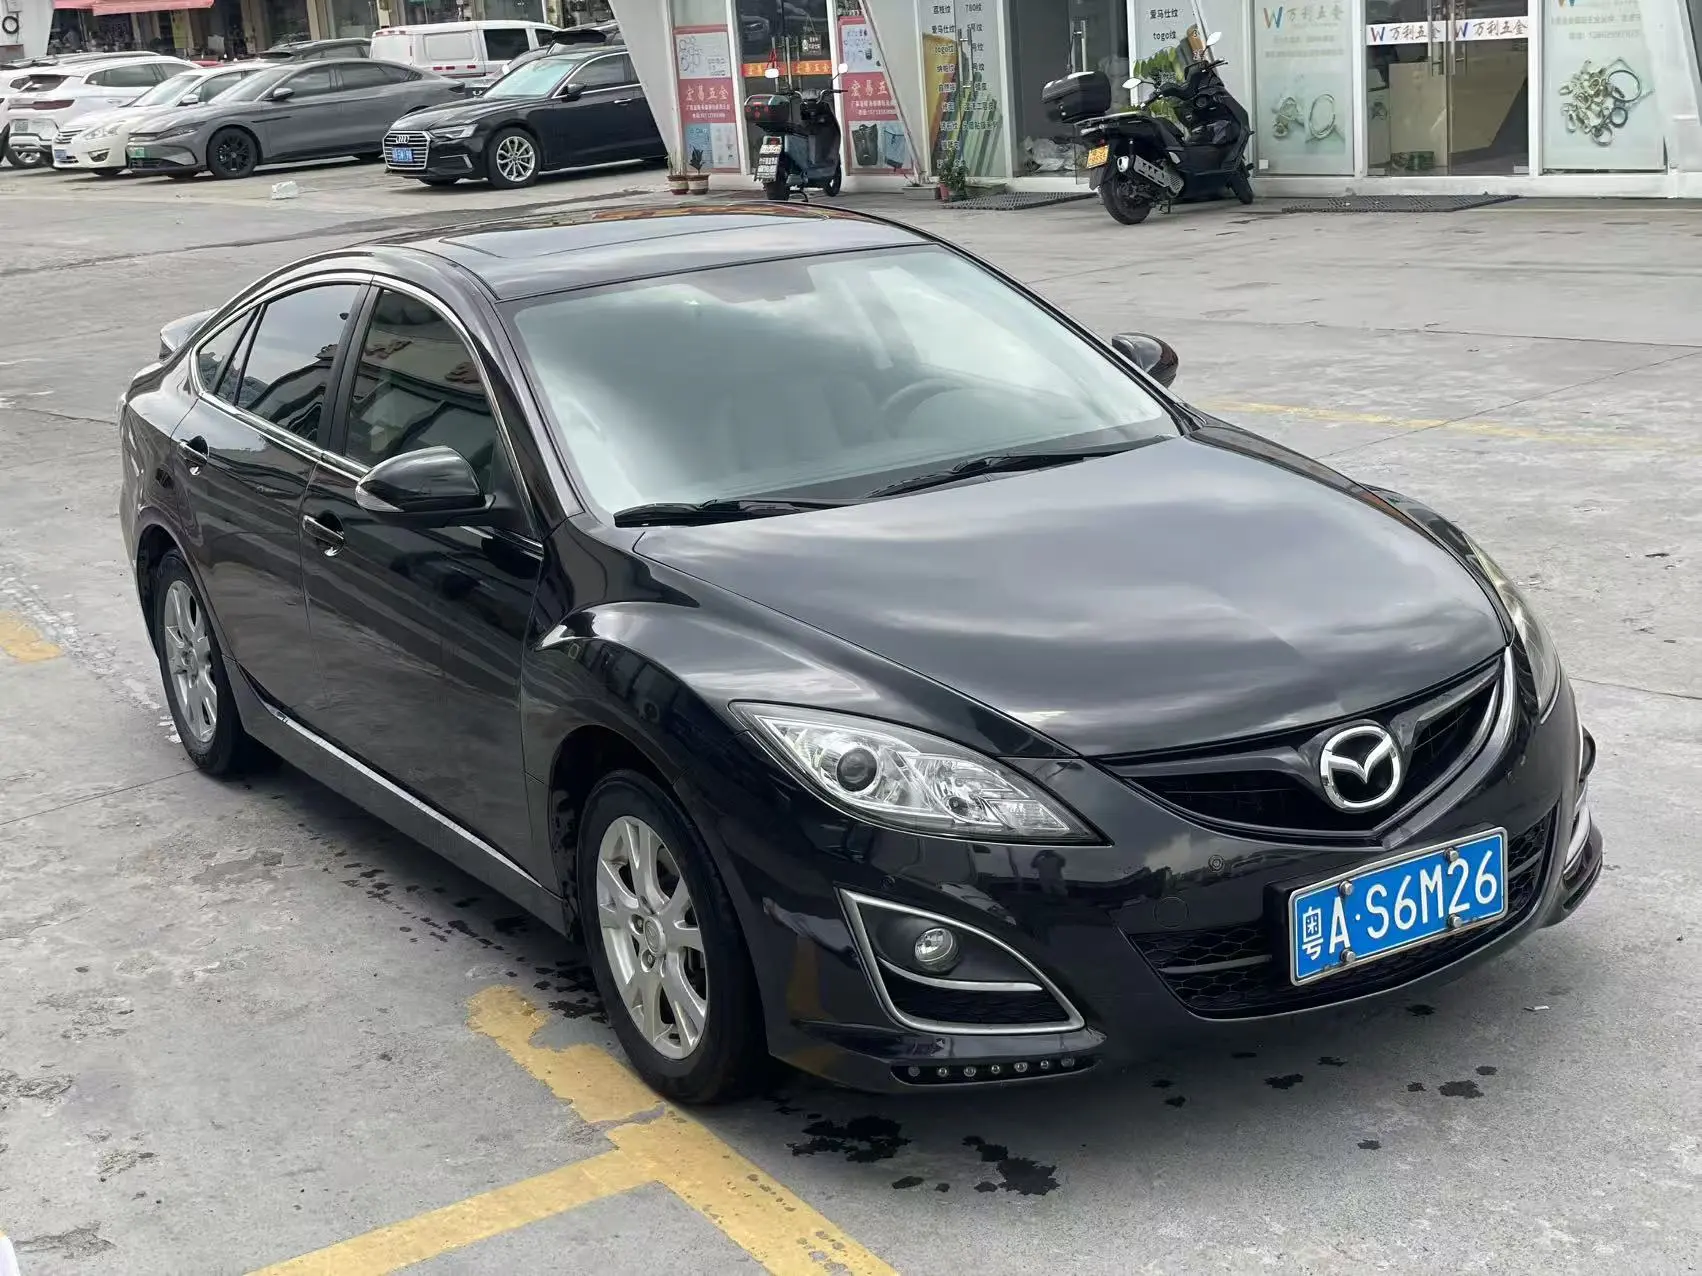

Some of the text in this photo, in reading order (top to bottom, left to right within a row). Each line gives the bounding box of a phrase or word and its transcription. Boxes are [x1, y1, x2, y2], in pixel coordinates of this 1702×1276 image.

[1150, 9, 1179, 19] 爱马仕纹
[1153, 30, 1177, 41] togo纹
[1473, 19, 1528, 38] 万利五金
[1302, 849, 1498, 961] 粤A·S6M26
